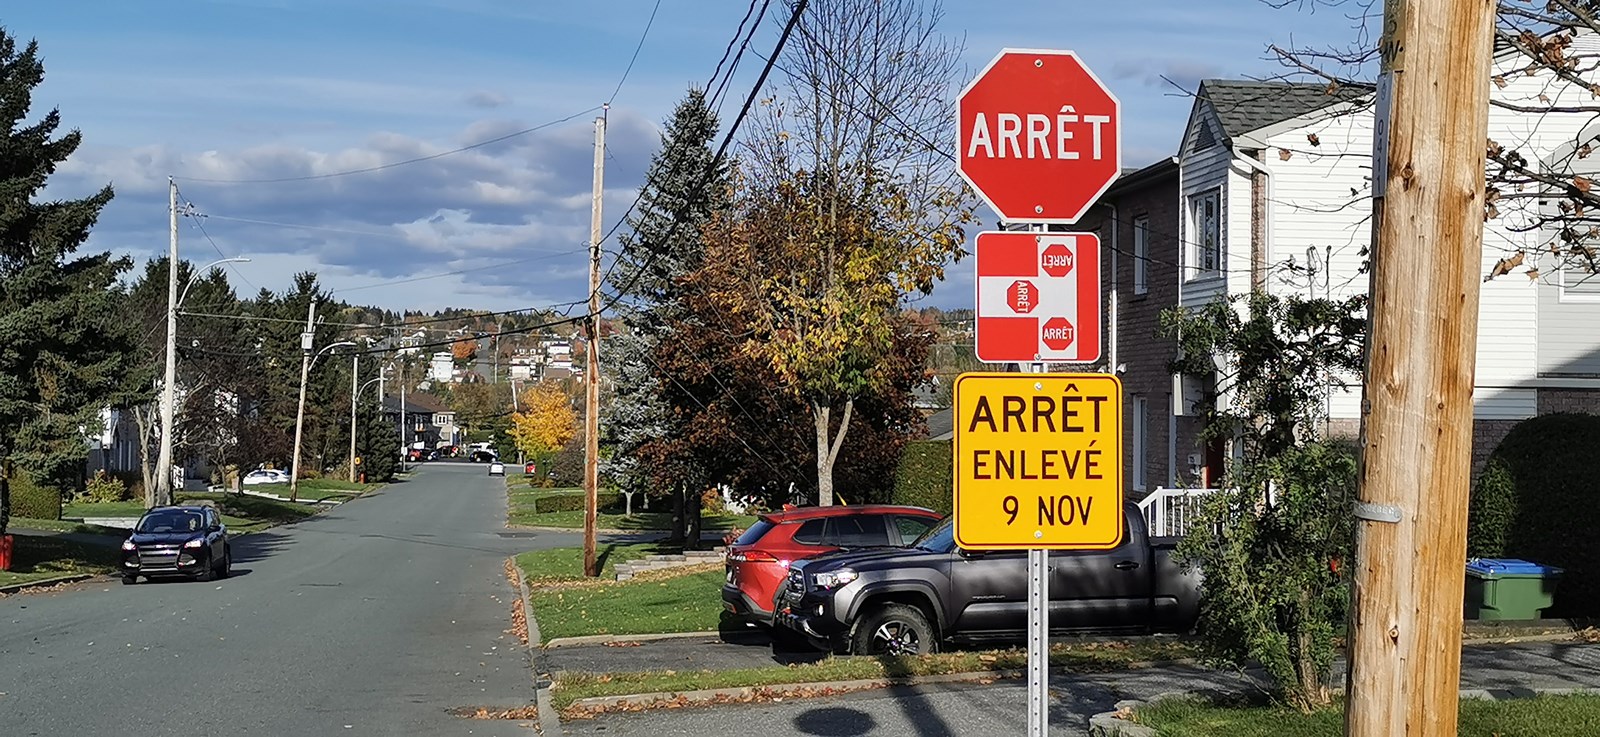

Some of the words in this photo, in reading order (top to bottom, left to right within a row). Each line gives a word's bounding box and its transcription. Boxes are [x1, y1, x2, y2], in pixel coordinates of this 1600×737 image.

[967, 105, 1110, 160] ARRÊT
[1043, 255, 1073, 268] ARRÊT
[1017, 281, 1031, 313] ARRÊT
[1043, 326, 1073, 340] ARRÊT
[968, 383, 1108, 433] ARRÊT
[973, 440, 1103, 480] ENLEVÉ
[1002, 495, 1019, 526] 9
[1038, 495, 1093, 526] NOV
